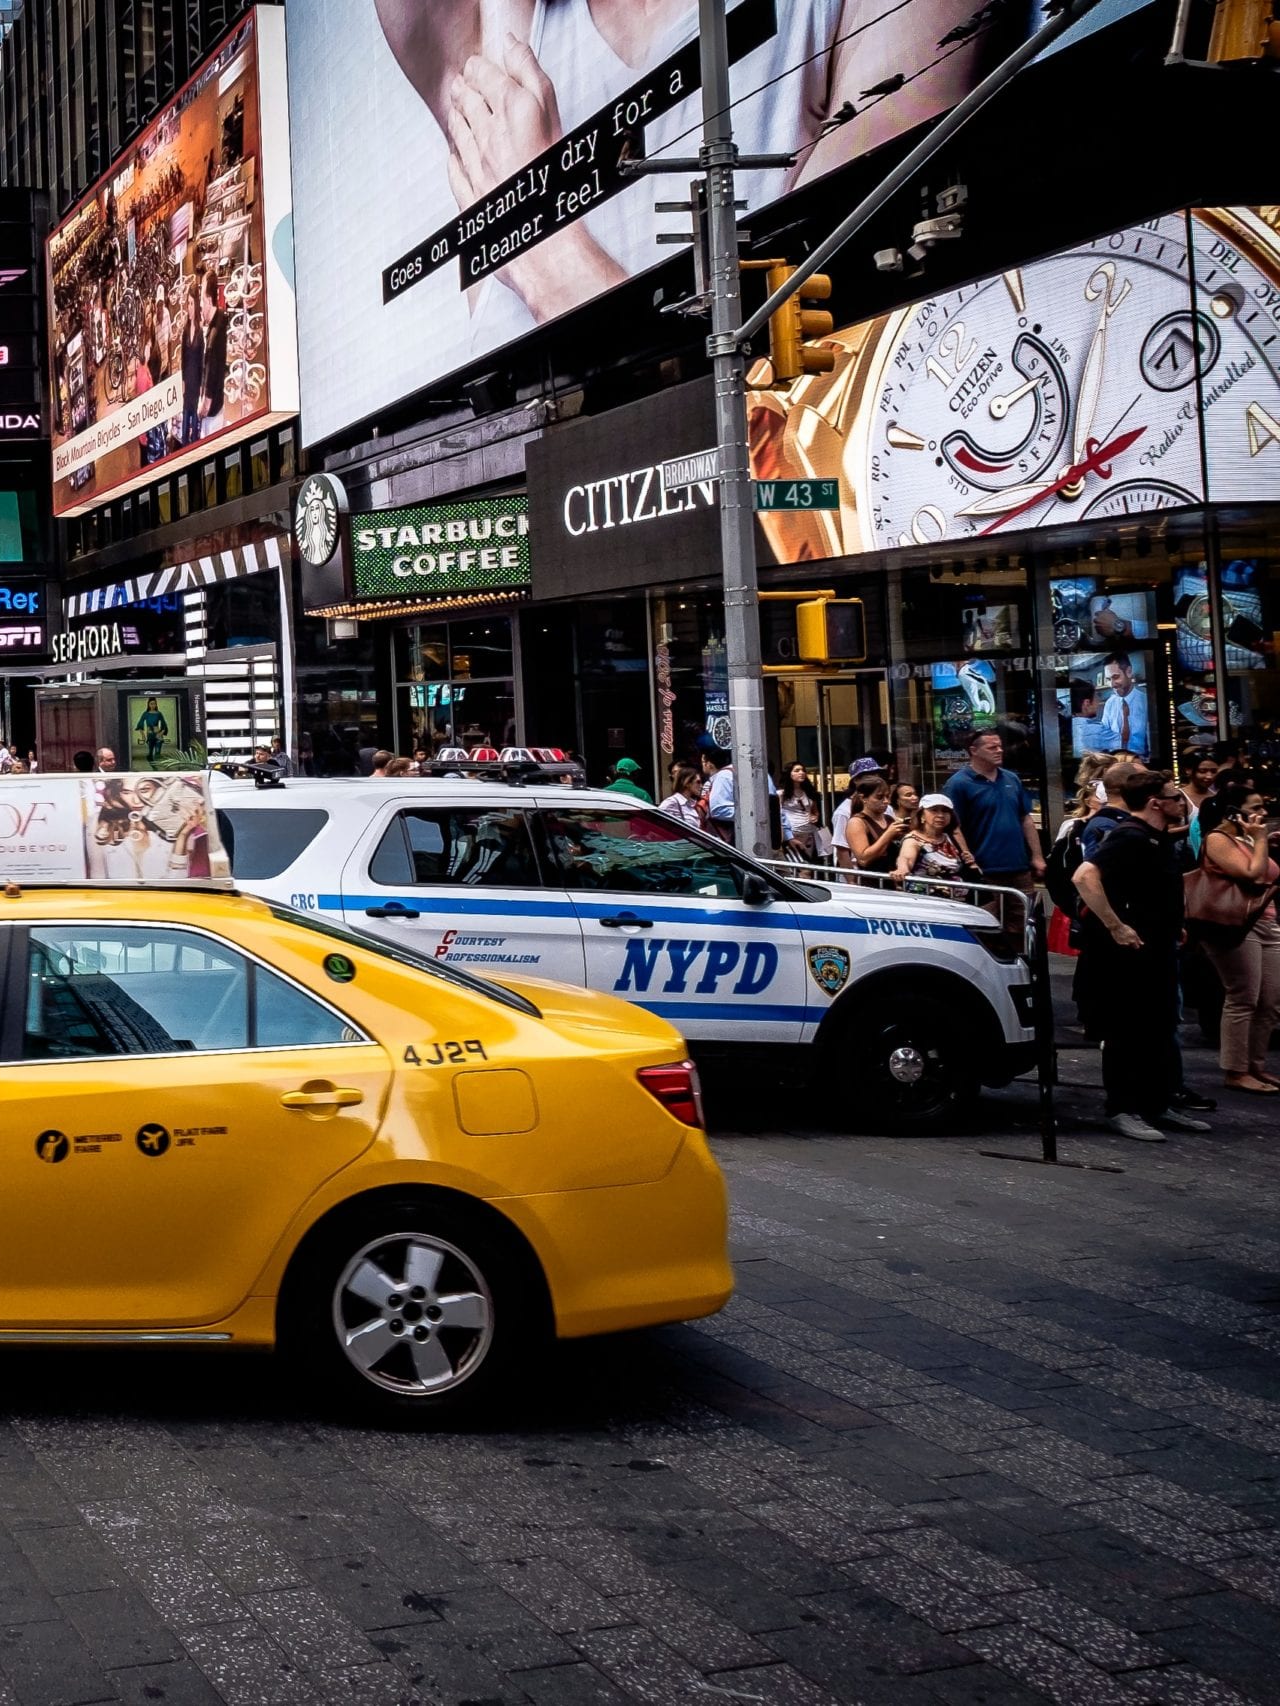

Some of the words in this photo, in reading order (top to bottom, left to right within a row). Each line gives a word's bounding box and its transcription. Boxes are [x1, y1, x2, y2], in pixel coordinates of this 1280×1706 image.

[390, 256, 423, 291] Goes
[430, 238, 450, 262] on
[457, 163, 550, 247] instantly
[560, 129, 598, 173] dry
[612, 88, 653, 137] for
[669, 68, 684, 95] a
[470, 213, 543, 276] cleaner
[555, 170, 605, 223] feel
[1208, 240, 1242, 274] DEL
[893, 342, 911, 369] PDL
[925, 321, 978, 389] 12
[949, 347, 999, 412] CITIZEN
[960, 361, 1005, 420] Eco-Drive
[127, 411, 141, 430] San
[141, 398, 166, 421] Diego,
[166, 385, 178, 407] CA
[879, 384, 894, 413] FEN
[1139, 420, 1185, 467] Radio
[1177, 352, 1257, 421] Controlled
[665, 452, 719, 487] BROADWAY
[871, 455, 881, 482] RIO
[759, 483, 776, 507] W
[785, 483, 812, 506] 43
[821, 483, 834, 496] ST
[947, 475, 970, 497] STD
[874, 505, 882, 531] SCL
[393, 546, 521, 577] COFFEE
[51, 621, 122, 663] SEPHORA
[290, 893, 316, 910] CRC
[441, 929, 507, 947] COURTESY
[869, 918, 932, 939] POLICE
[434, 945, 542, 965] PROFESSIONALISM
[613, 938, 779, 995] NYPD
[403, 1039, 489, 1067] 4J29
[73, 1133, 123, 1144] METERED
[173, 1127, 200, 1138] FLAT
[200, 1126, 229, 1136] FARE
[73, 1144, 102, 1154] FARE
